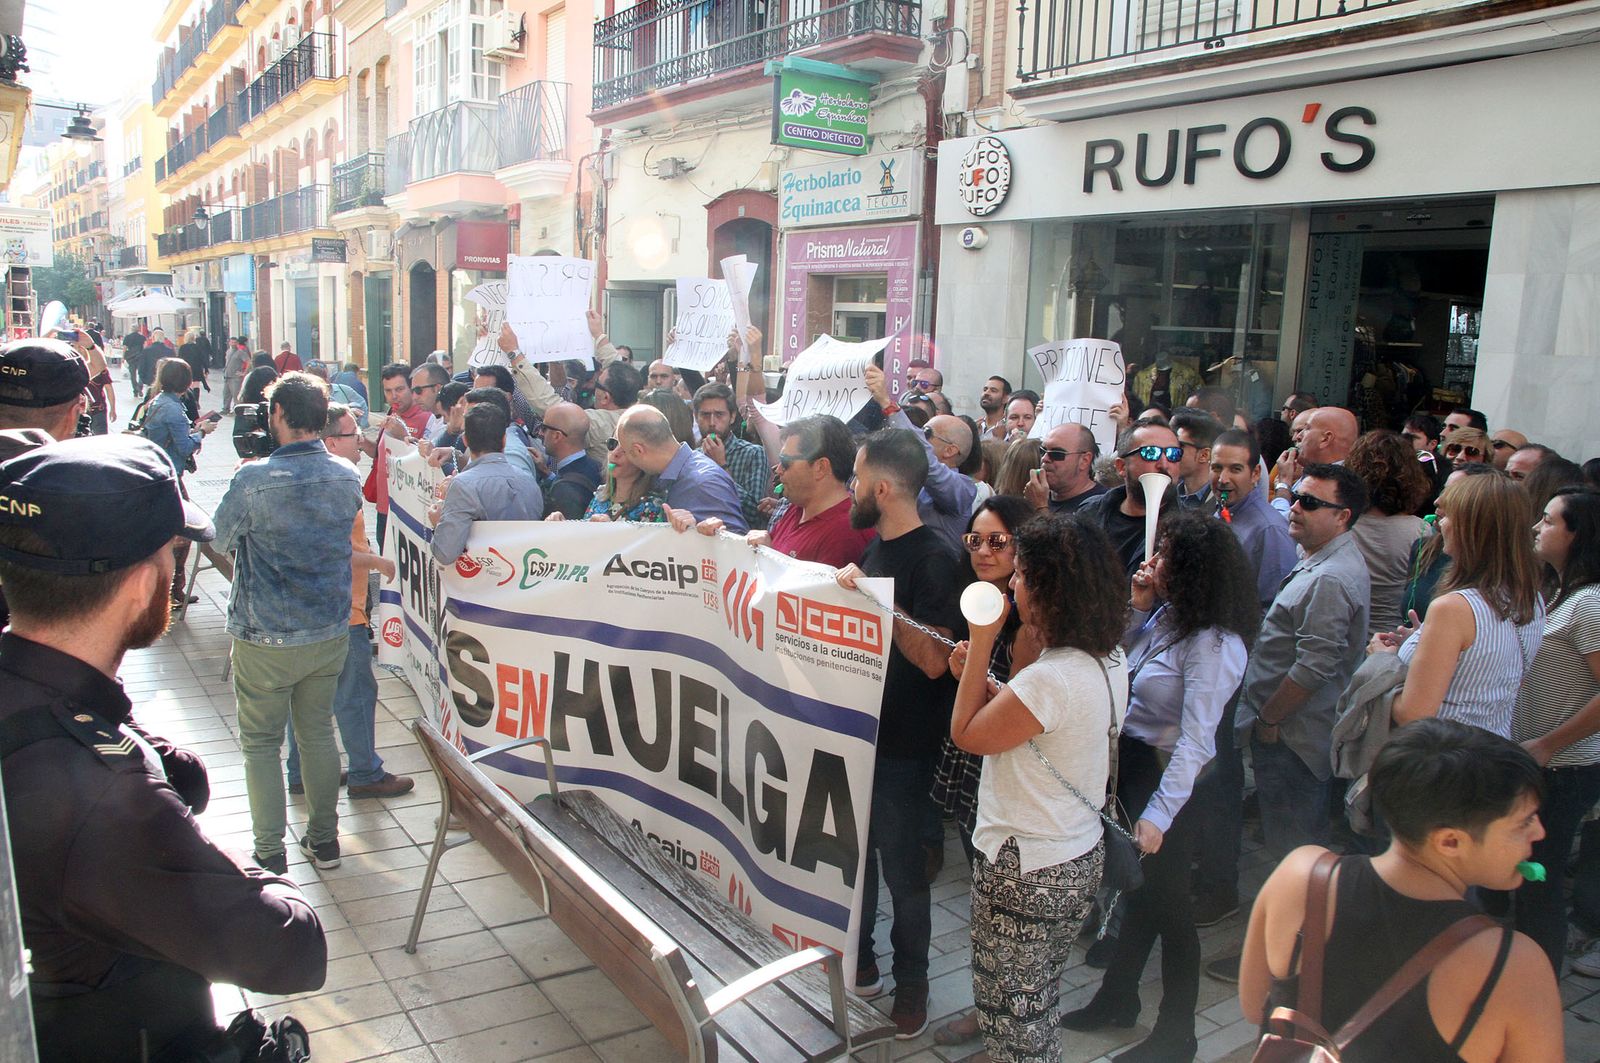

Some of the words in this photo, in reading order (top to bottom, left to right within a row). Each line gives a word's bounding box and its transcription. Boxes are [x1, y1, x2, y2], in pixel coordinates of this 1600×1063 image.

[819, 92, 868, 110] Herbolario
[786, 125, 819, 139] CENTRO
[820, 131, 861, 145] DIETETICO
[1082, 102, 1378, 194] RUFO'S
[782, 167, 862, 193] Herbolario
[782, 195, 861, 222] Equinacea
[866, 194, 908, 209] TEGOR
[464, 255, 501, 264] PRONOVIAS
[1, 365, 28, 377] CNP
[1034, 347, 1125, 386] PRISIONES
[530, 560, 557, 578] CSIF
[602, 553, 699, 589] Acaip
[806, 607, 879, 646] CCOO
[775, 632, 811, 650] servicios
[812, 644, 818, 652] a
[820, 644, 829, 656] la
[816, 658, 871, 678] penitenciarias
[495, 662, 549, 747] EN
[550, 650, 861, 890] HUELGA
